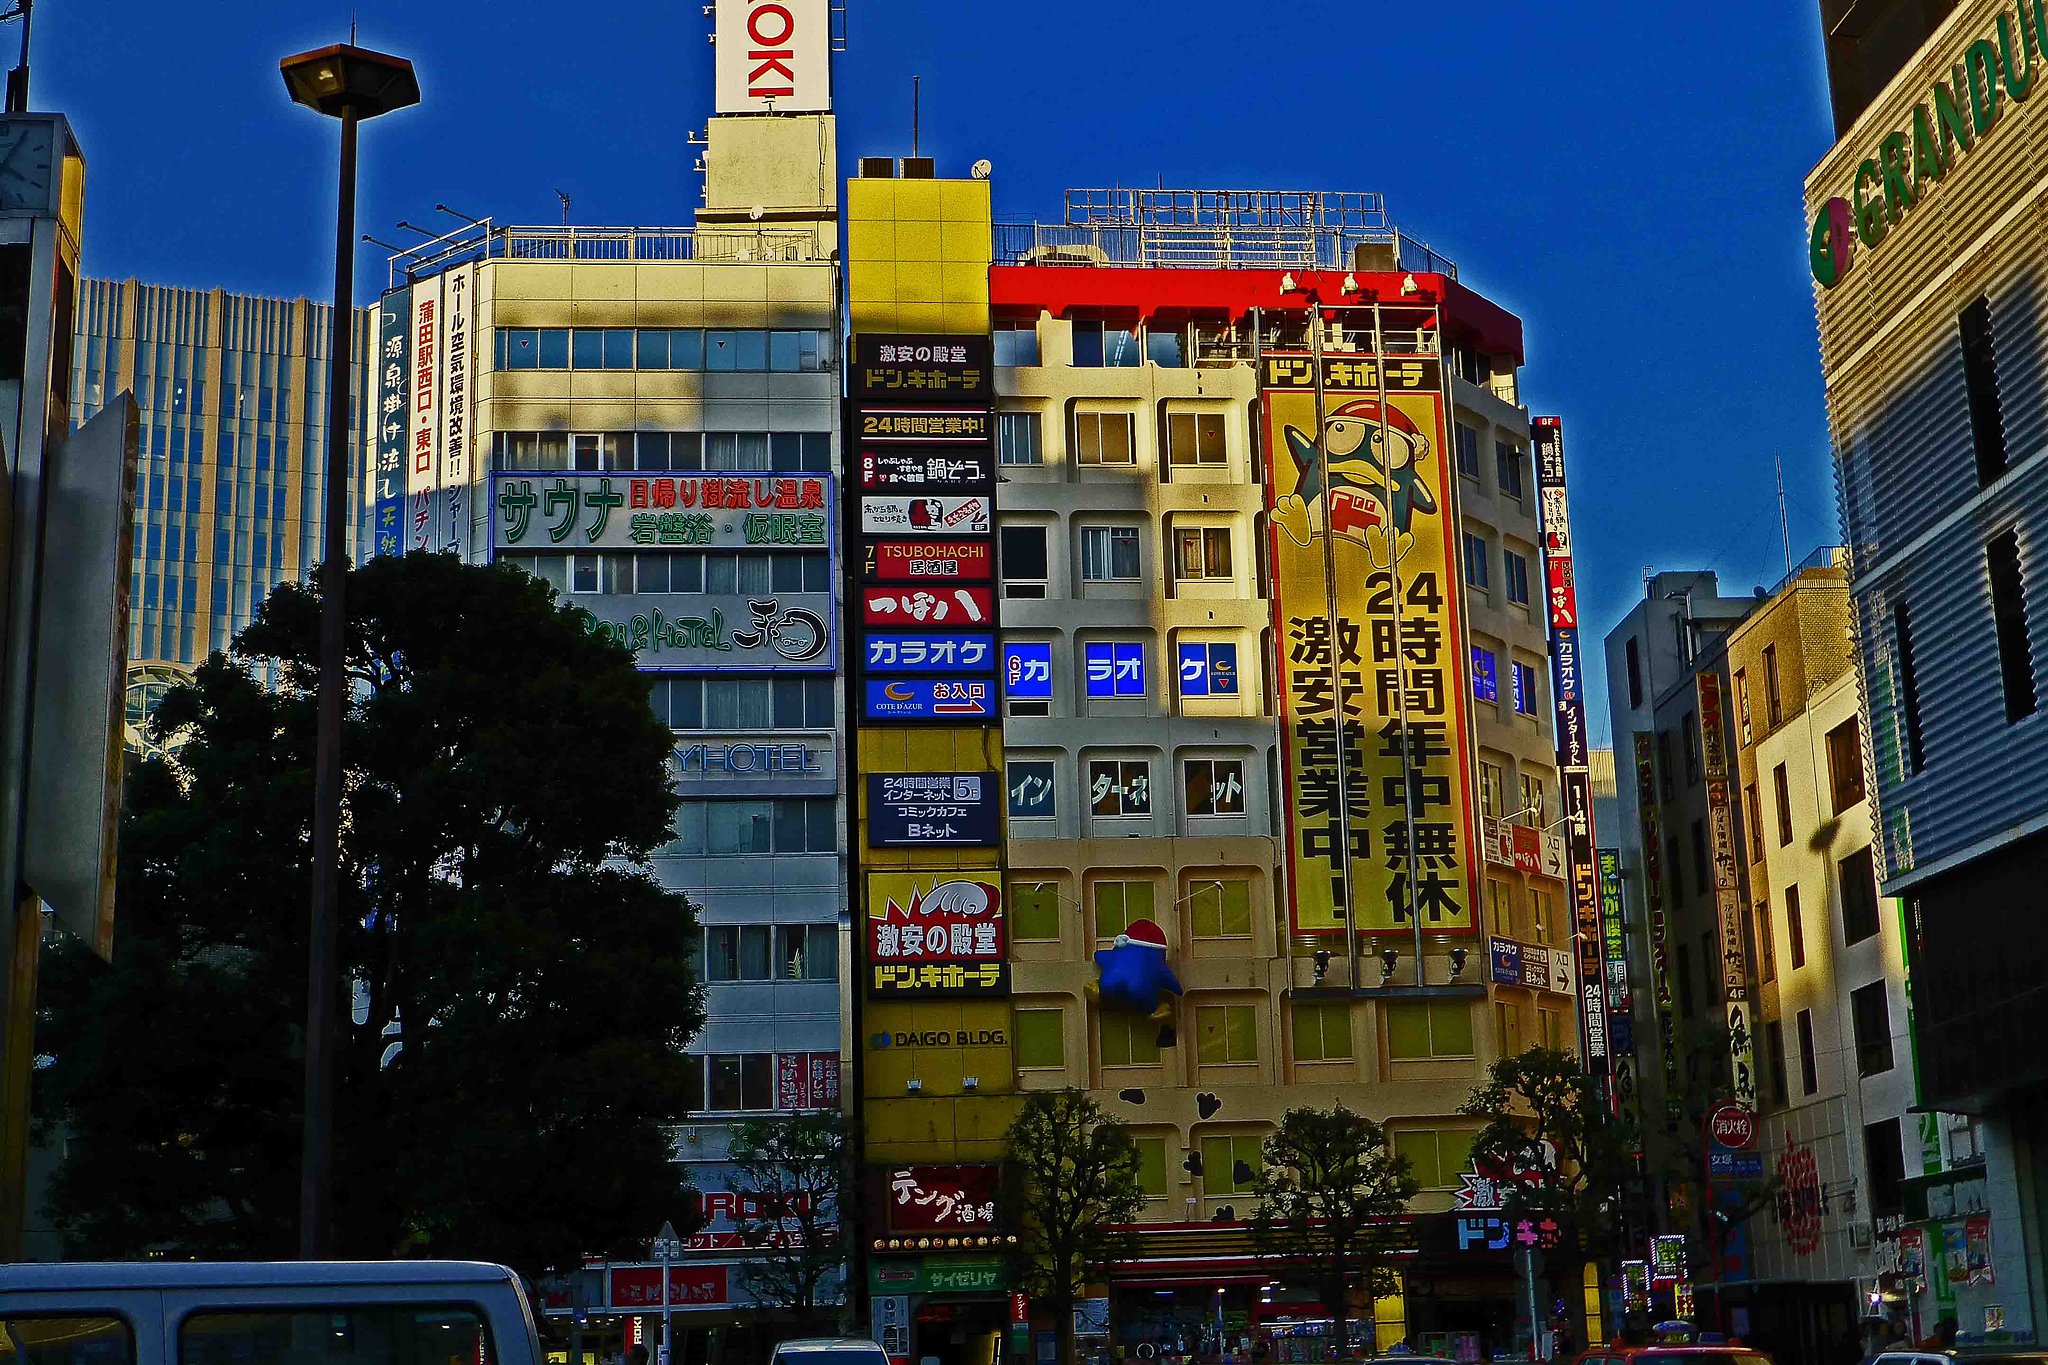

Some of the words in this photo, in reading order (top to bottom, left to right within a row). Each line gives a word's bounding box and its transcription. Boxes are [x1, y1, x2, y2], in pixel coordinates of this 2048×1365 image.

[747, 0, 794, 97] OKI
[880, 345, 967, 363] 激安の殿堂
[864, 416, 985, 433] 24時間営業中!
[926, 458, 981, 480] 鍋ぞう
[630, 479, 825, 509] 日帰り掛流し温泉
[499, 479, 622, 544] サウナ
[631, 513, 826, 545] 岩盤浴・仮眠室
[884, 546, 984, 558] TSUBOHACHI
[909, 560, 959, 575] 居酒屋
[868, 589, 983, 622] つぼ八
[870, 640, 987, 664] カラオケ
[1559, 642, 1575, 691] カラオケ
[933, 683, 985, 699] お入口
[1566, 705, 1581, 765] インターネット
[1365, 572, 1462, 923] 24時間年中無休
[1288, 616, 1371, 920] 激安営業中!
[883, 777, 950, 789] 24時間営業
[883, 789, 950, 801] インターネット
[897, 806, 967, 817] コミックカフェ
[908, 823, 957, 838] Bネット
[1547, 836, 1560, 851] 入口
[1600, 855, 1623, 960] まんが喫茶
[876, 924, 997, 956] 激安の殿堂
[1492, 941, 1517, 955] カラオケ
[1555, 953, 1569, 967] 入口
[1730, 989, 1745, 999] 4F
[1584, 984, 1605, 1057] 24時間営業
[895, 1031, 950, 1047] DAIGO
[957, 1029, 1007, 1046] BLDG.
[1716, 1119, 1748, 1135] 消火栓
